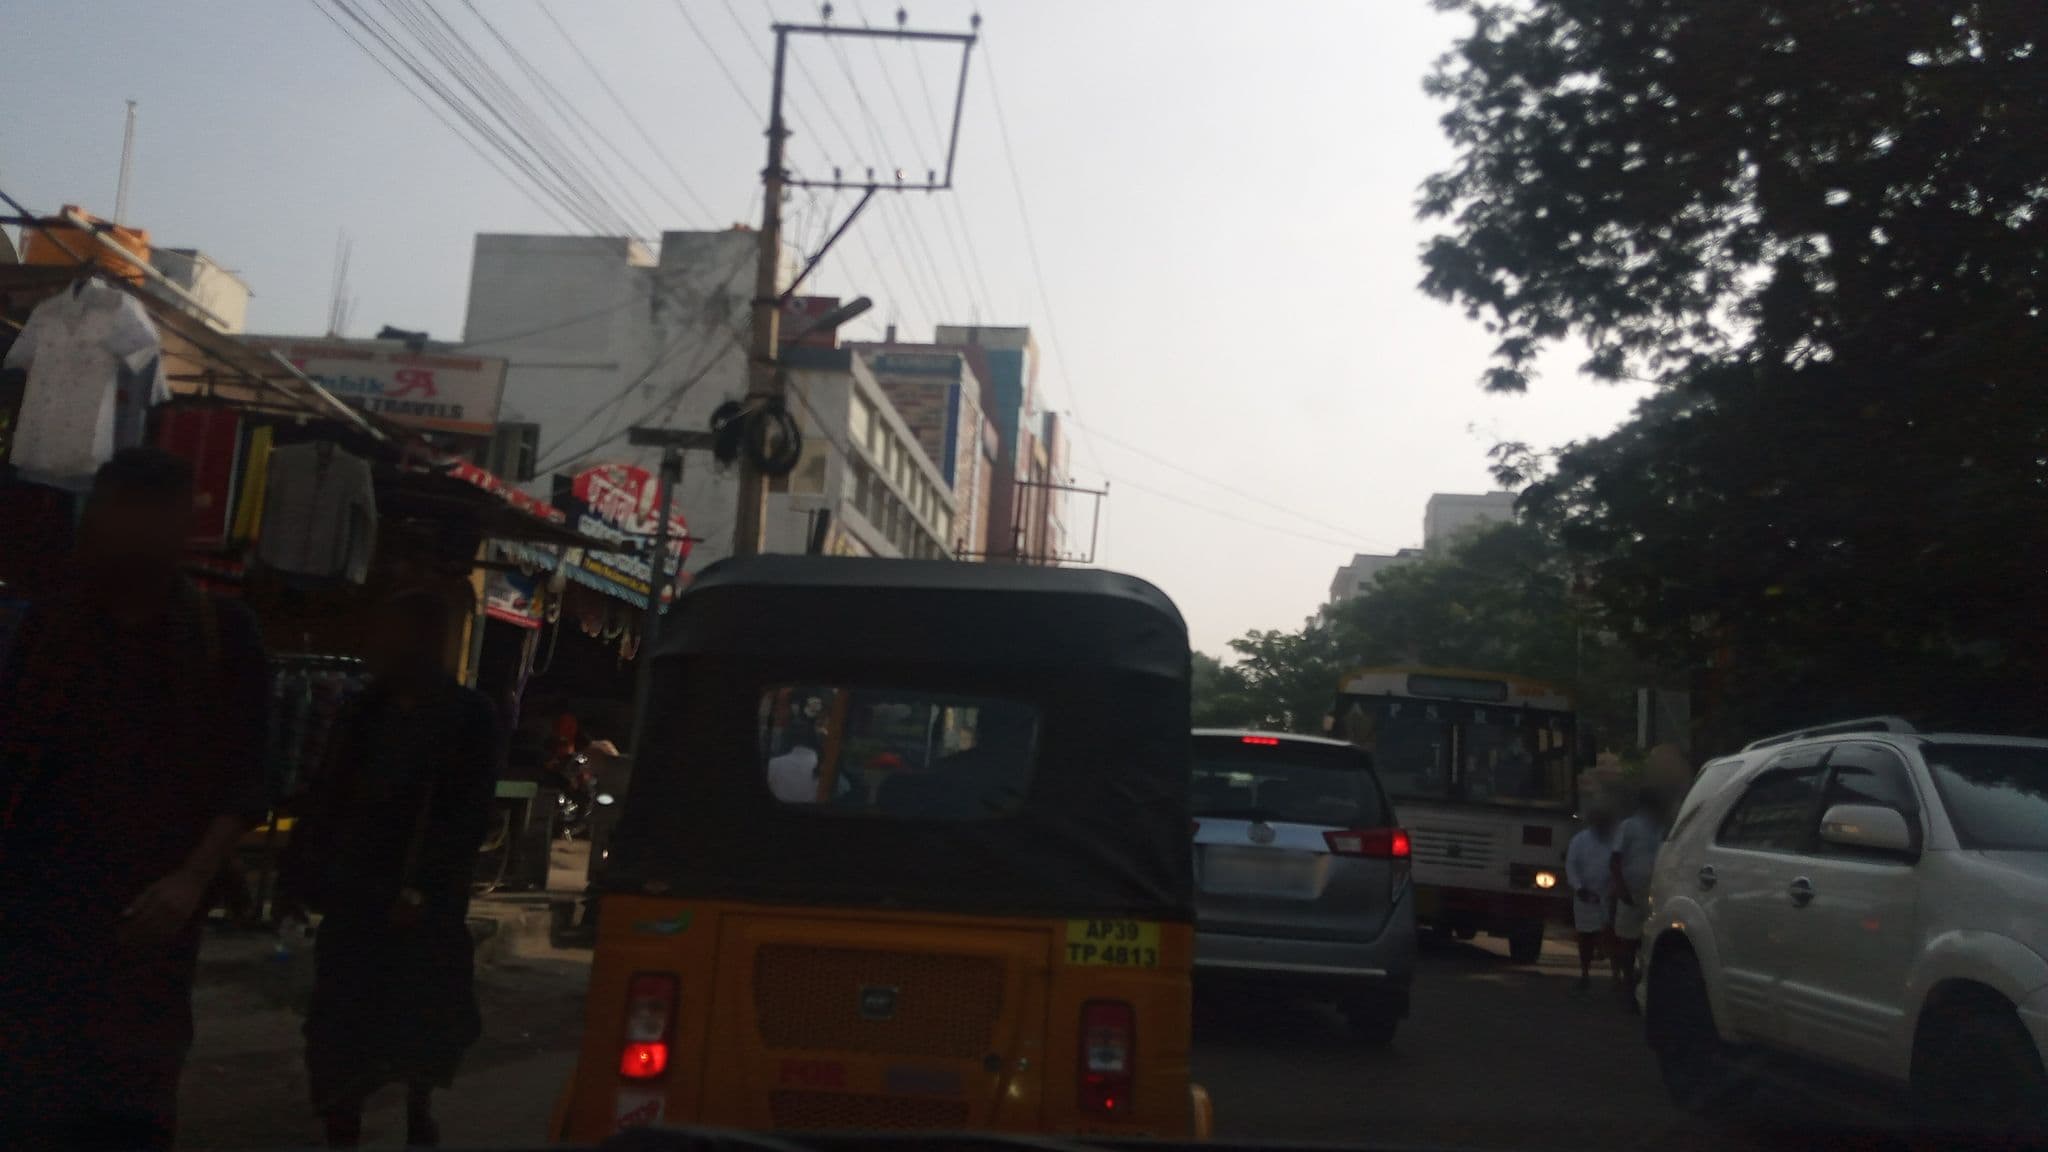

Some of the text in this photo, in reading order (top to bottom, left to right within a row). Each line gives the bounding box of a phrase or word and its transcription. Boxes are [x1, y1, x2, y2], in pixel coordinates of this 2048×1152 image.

[373, 398, 465, 419] TRAVELS
[1086, 919, 1138, 941] AP39
[1066, 943, 1157, 967] TP 4813
